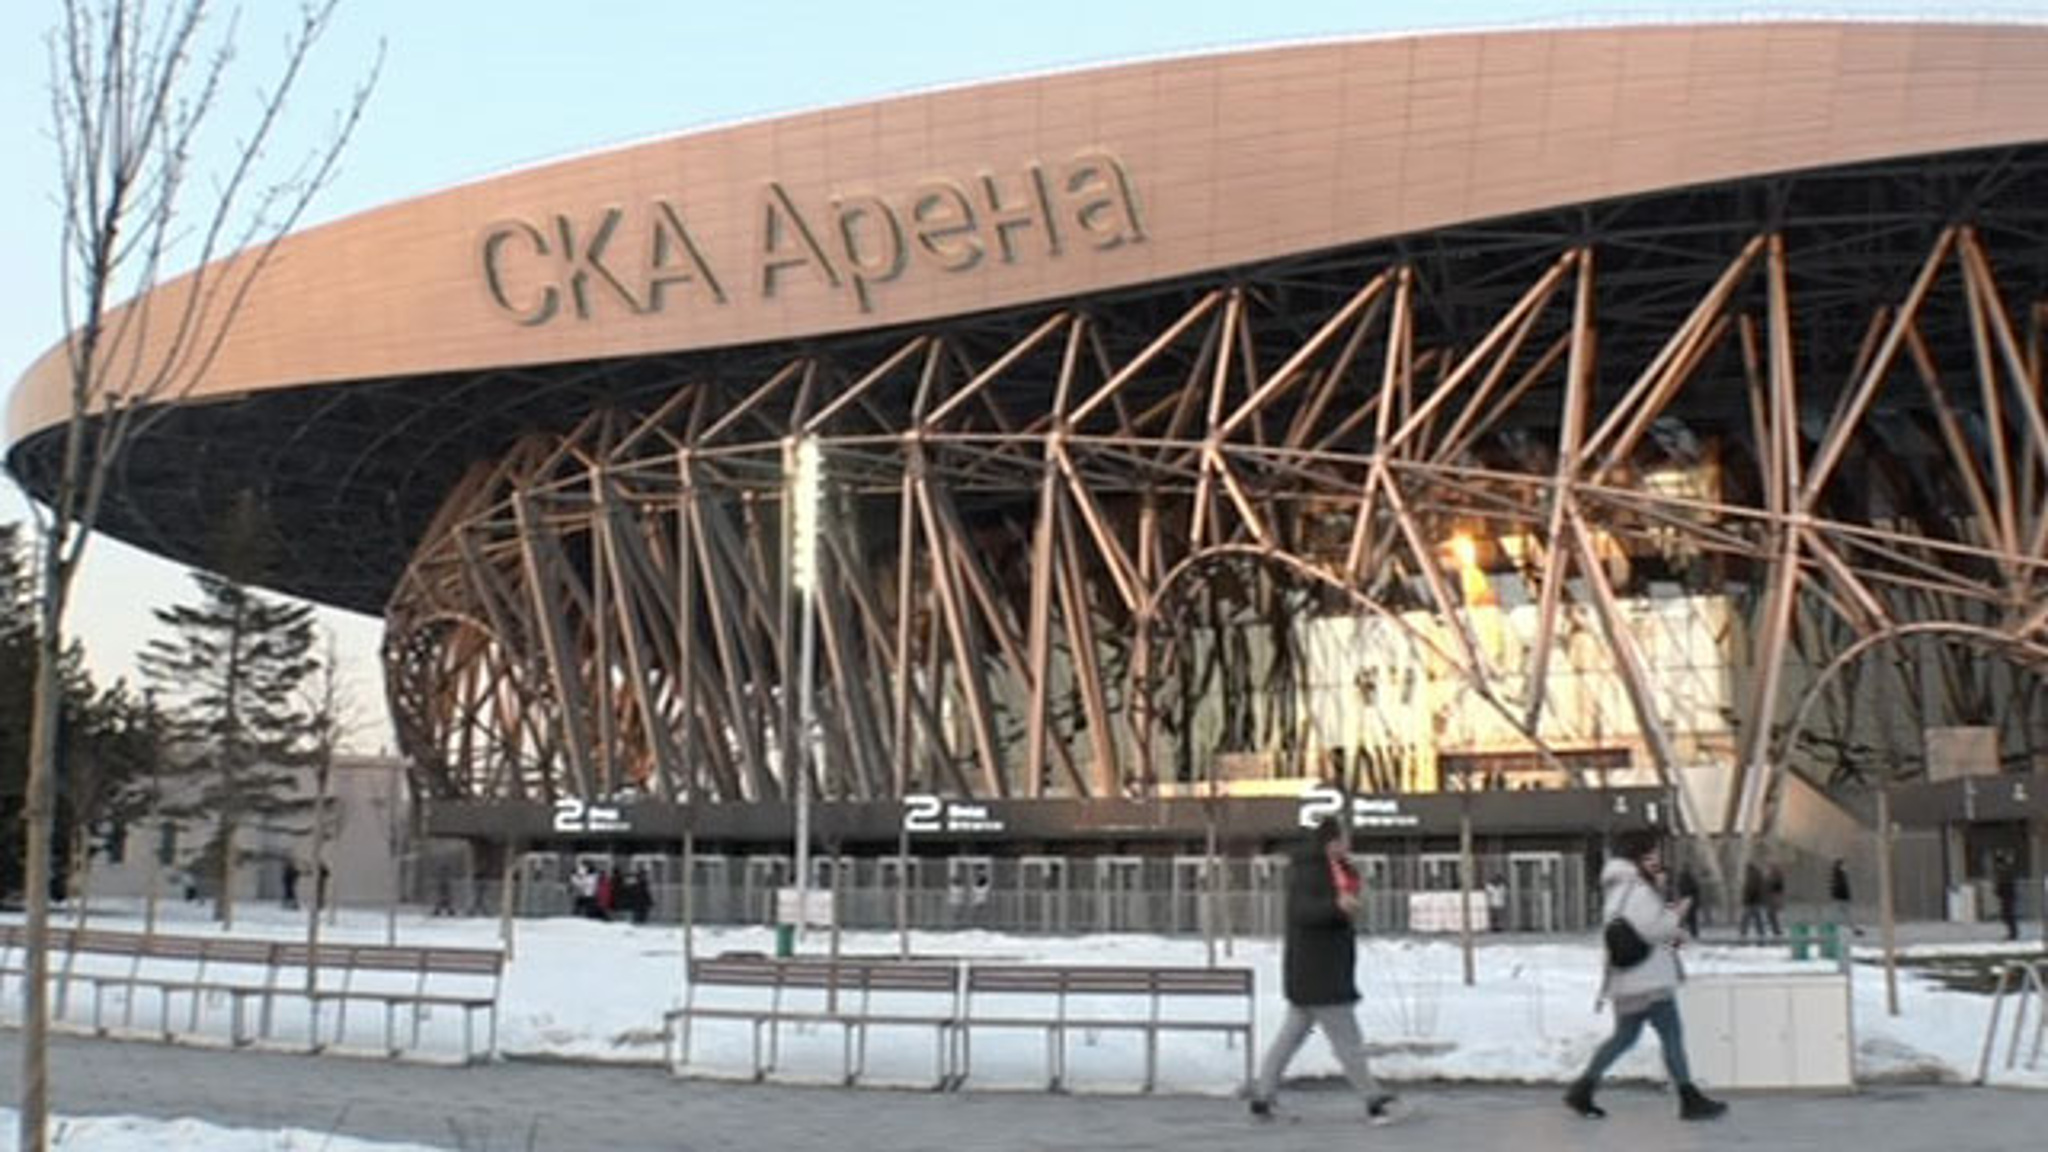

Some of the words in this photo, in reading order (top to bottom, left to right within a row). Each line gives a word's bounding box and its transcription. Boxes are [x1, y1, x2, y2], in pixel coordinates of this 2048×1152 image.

[478, 193, 728, 327] СКА
[761, 144, 1148, 314] Арена
[554, 797, 583, 832] 2
[904, 795, 941, 831] 2
